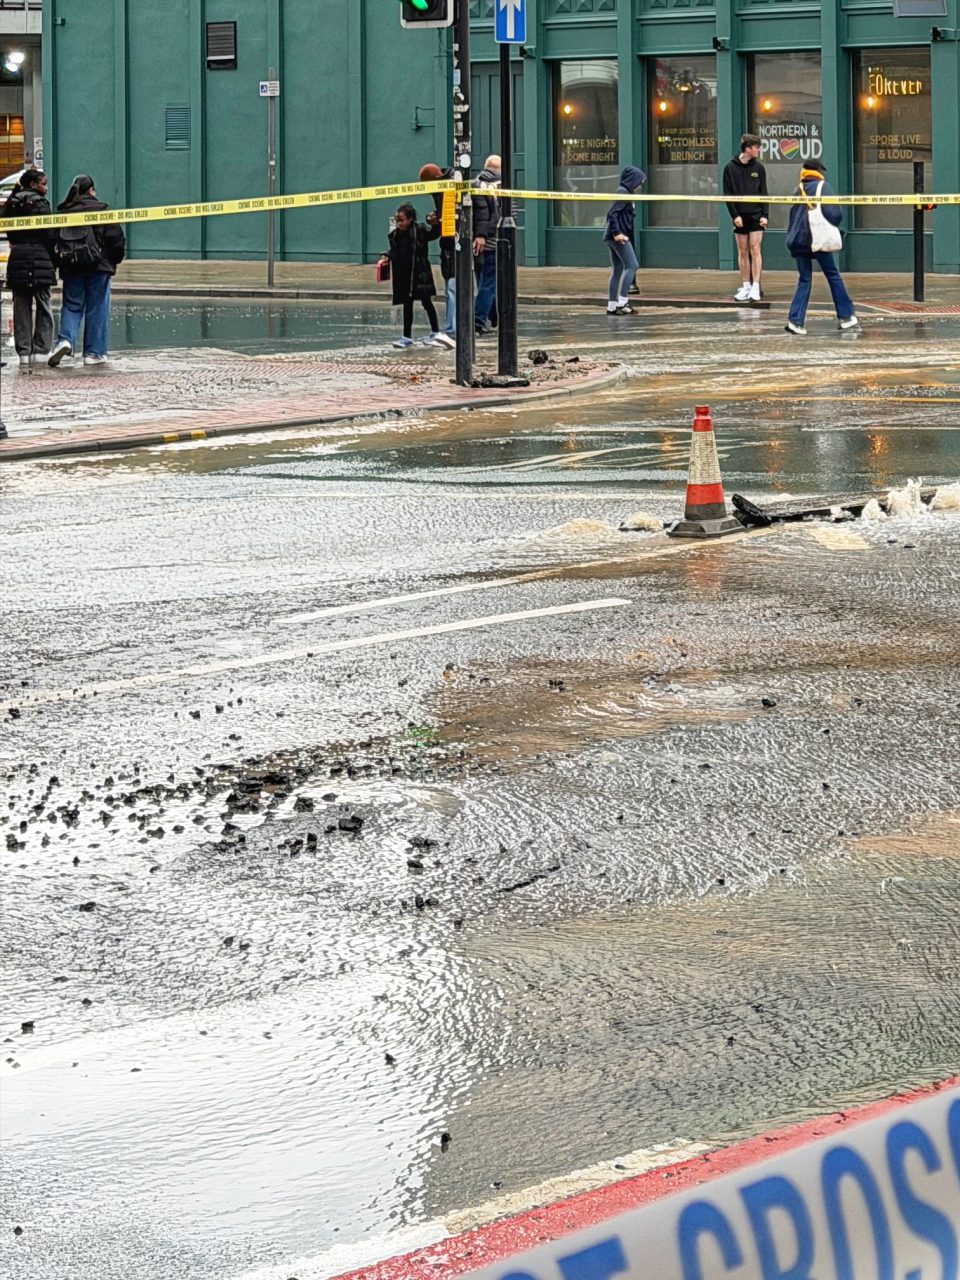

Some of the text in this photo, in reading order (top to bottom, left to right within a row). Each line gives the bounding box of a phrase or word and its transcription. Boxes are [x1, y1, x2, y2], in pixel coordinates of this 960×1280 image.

[759, 123, 819, 137] NORTHERN &
[586, 138, 616, 148] NIGHTS
[901, 134, 921, 144] LIVE
[591, 151, 615, 161] RIGHT
[671, 151, 705, 161] BRUNCH
[888, 149, 913, 160] LOUD
